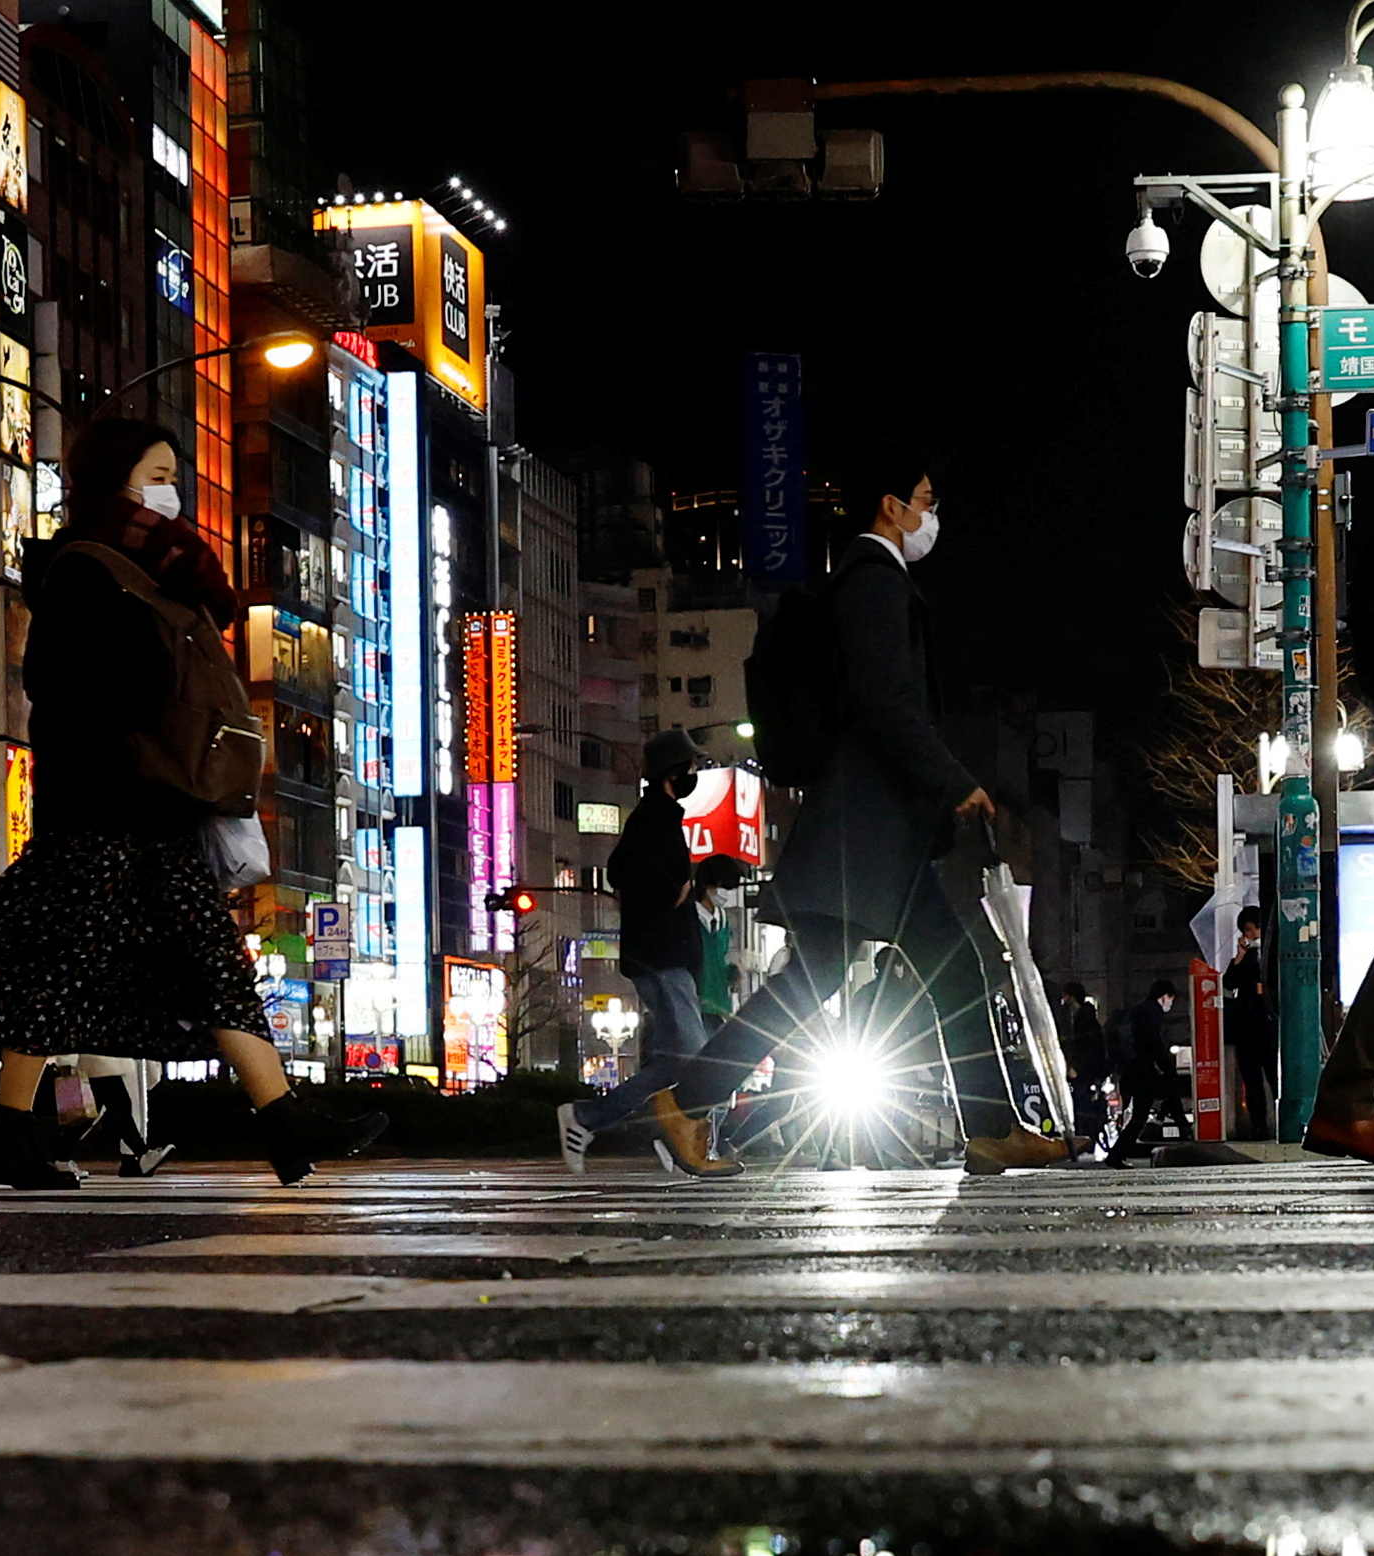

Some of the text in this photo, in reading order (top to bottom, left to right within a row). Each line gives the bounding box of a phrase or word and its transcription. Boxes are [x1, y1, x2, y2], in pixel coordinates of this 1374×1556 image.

[443, 252, 466, 306] 快活
[445, 299, 467, 341] CLUB
[762, 395, 789, 571] オザキクリニック
[317, 907, 340, 937] P
